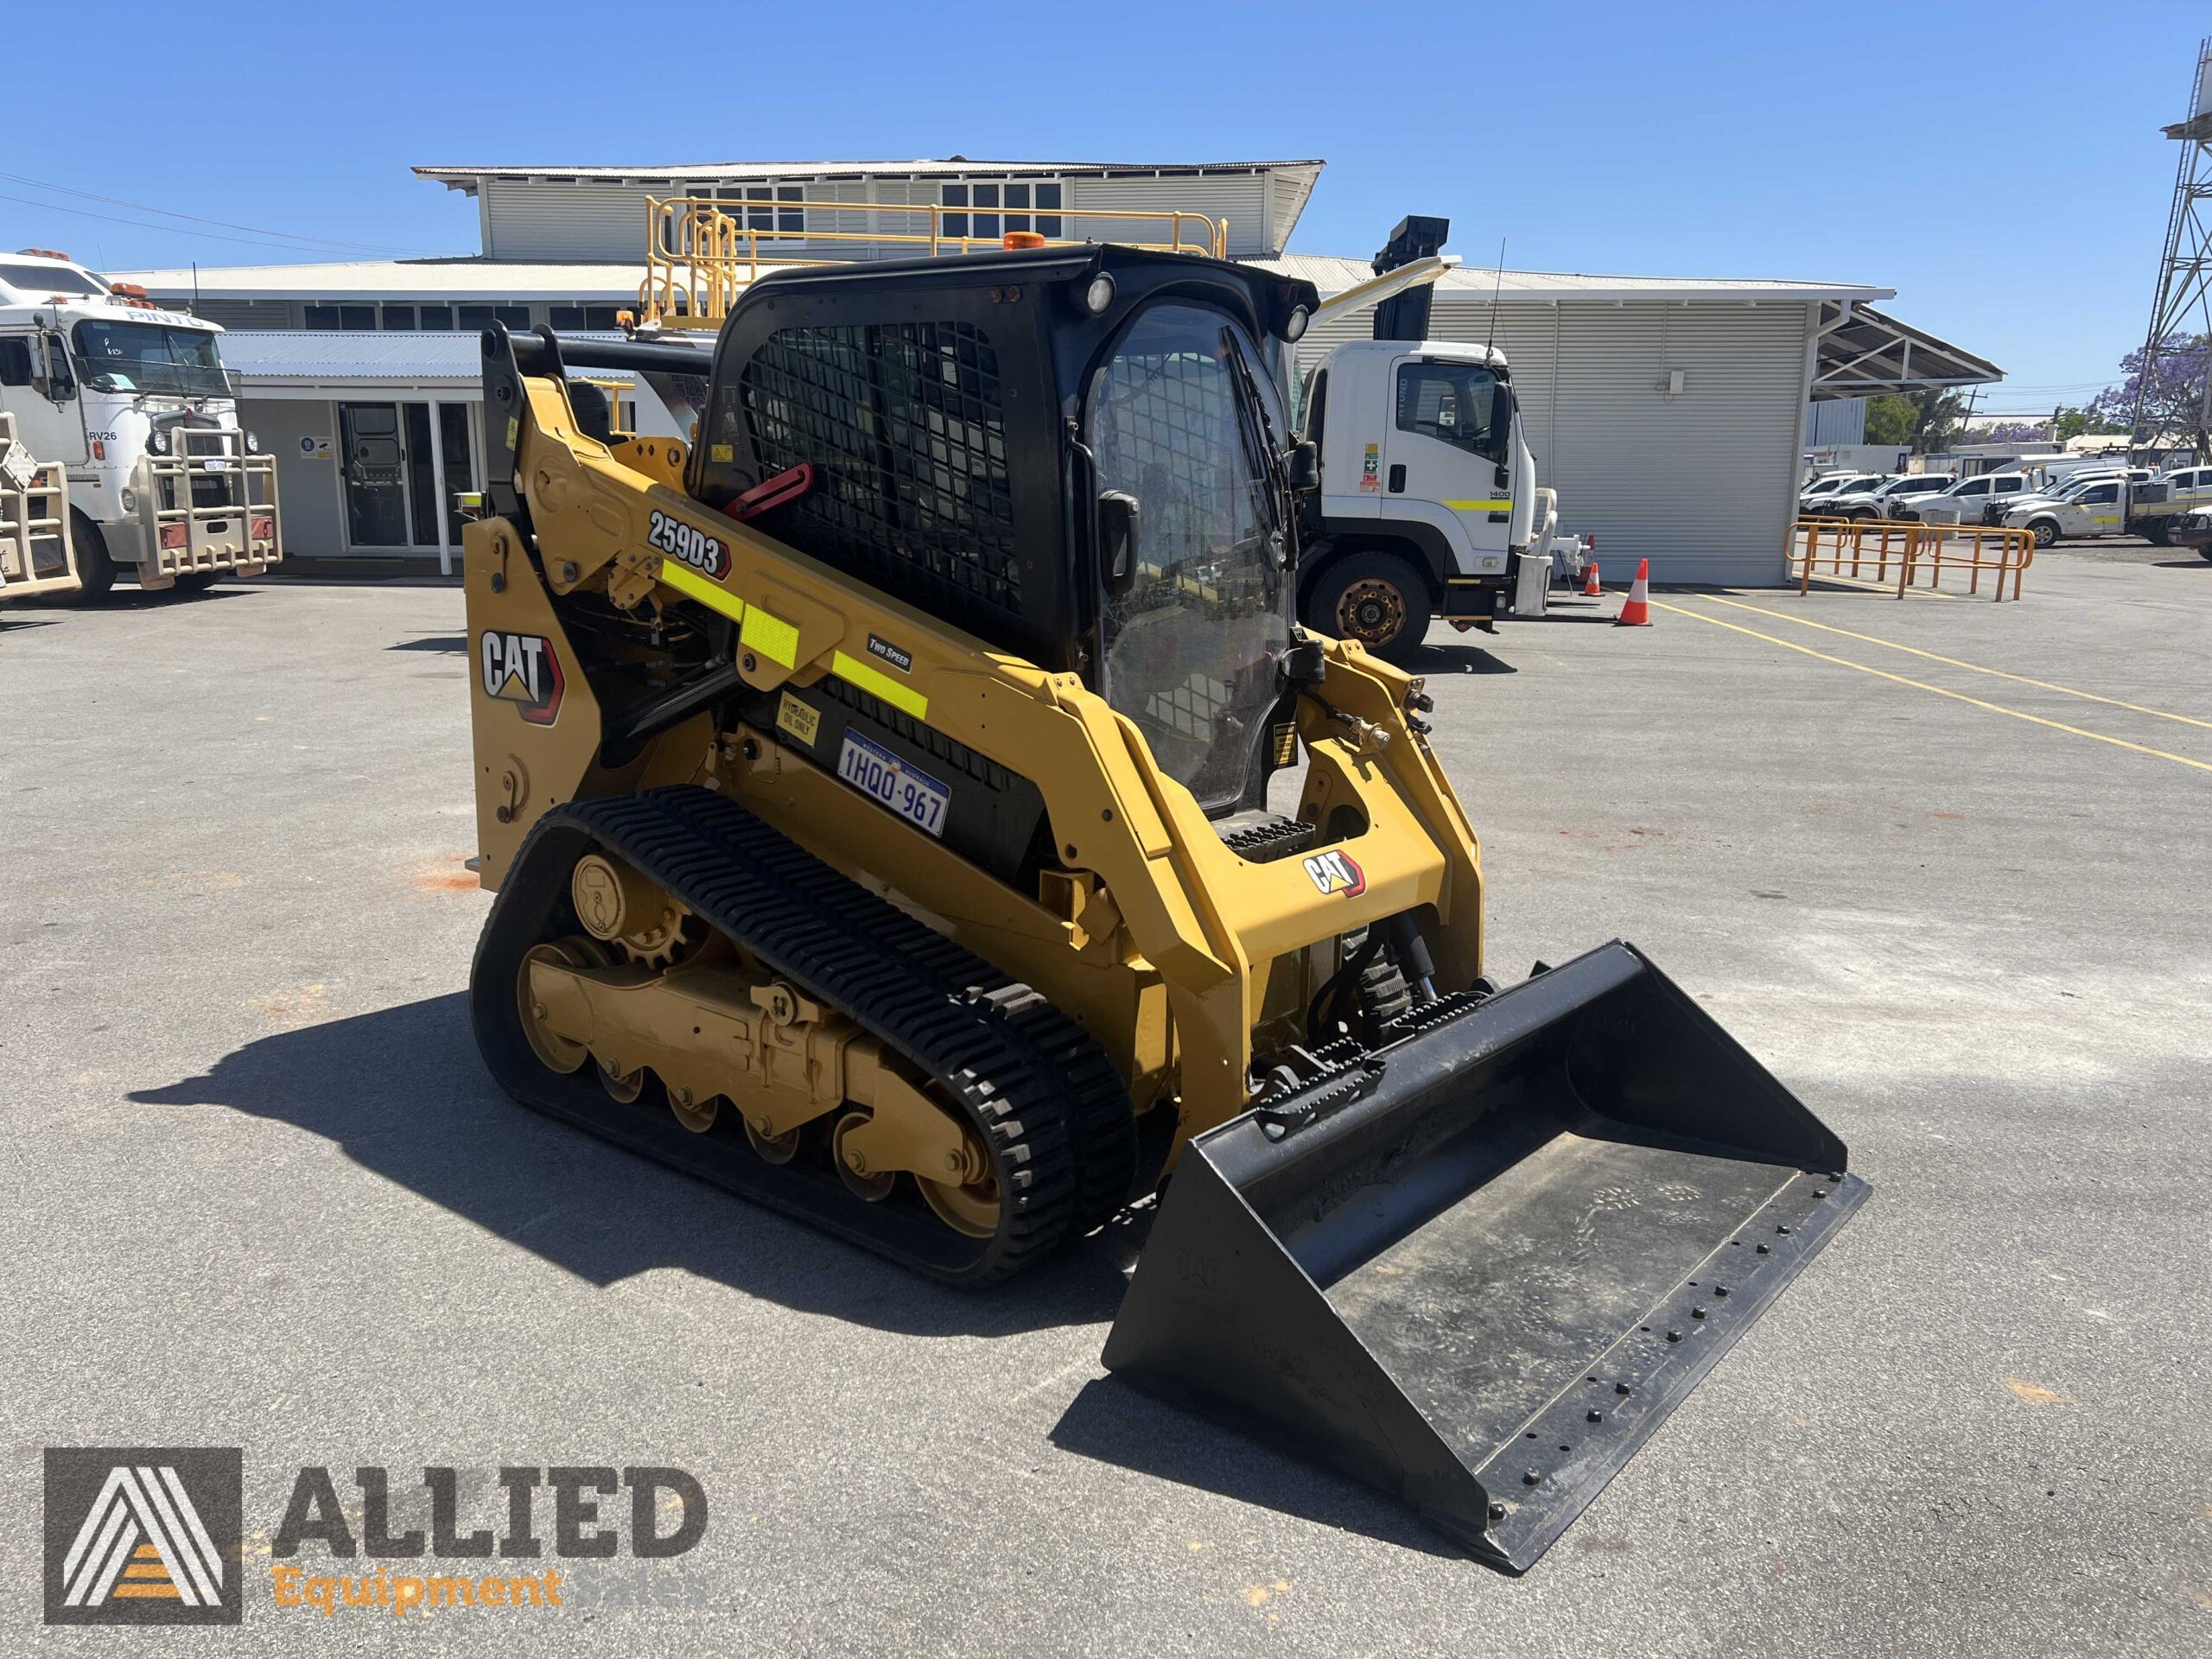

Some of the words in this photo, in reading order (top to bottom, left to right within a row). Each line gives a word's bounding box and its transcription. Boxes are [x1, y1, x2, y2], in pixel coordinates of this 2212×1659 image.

[126, 311, 204, 327] PINTO
[90, 432, 118, 441] RV26
[649, 511, 719, 574] 259D3
[482, 632, 543, 702] CAT
[1303, 851, 1354, 893] CAT
